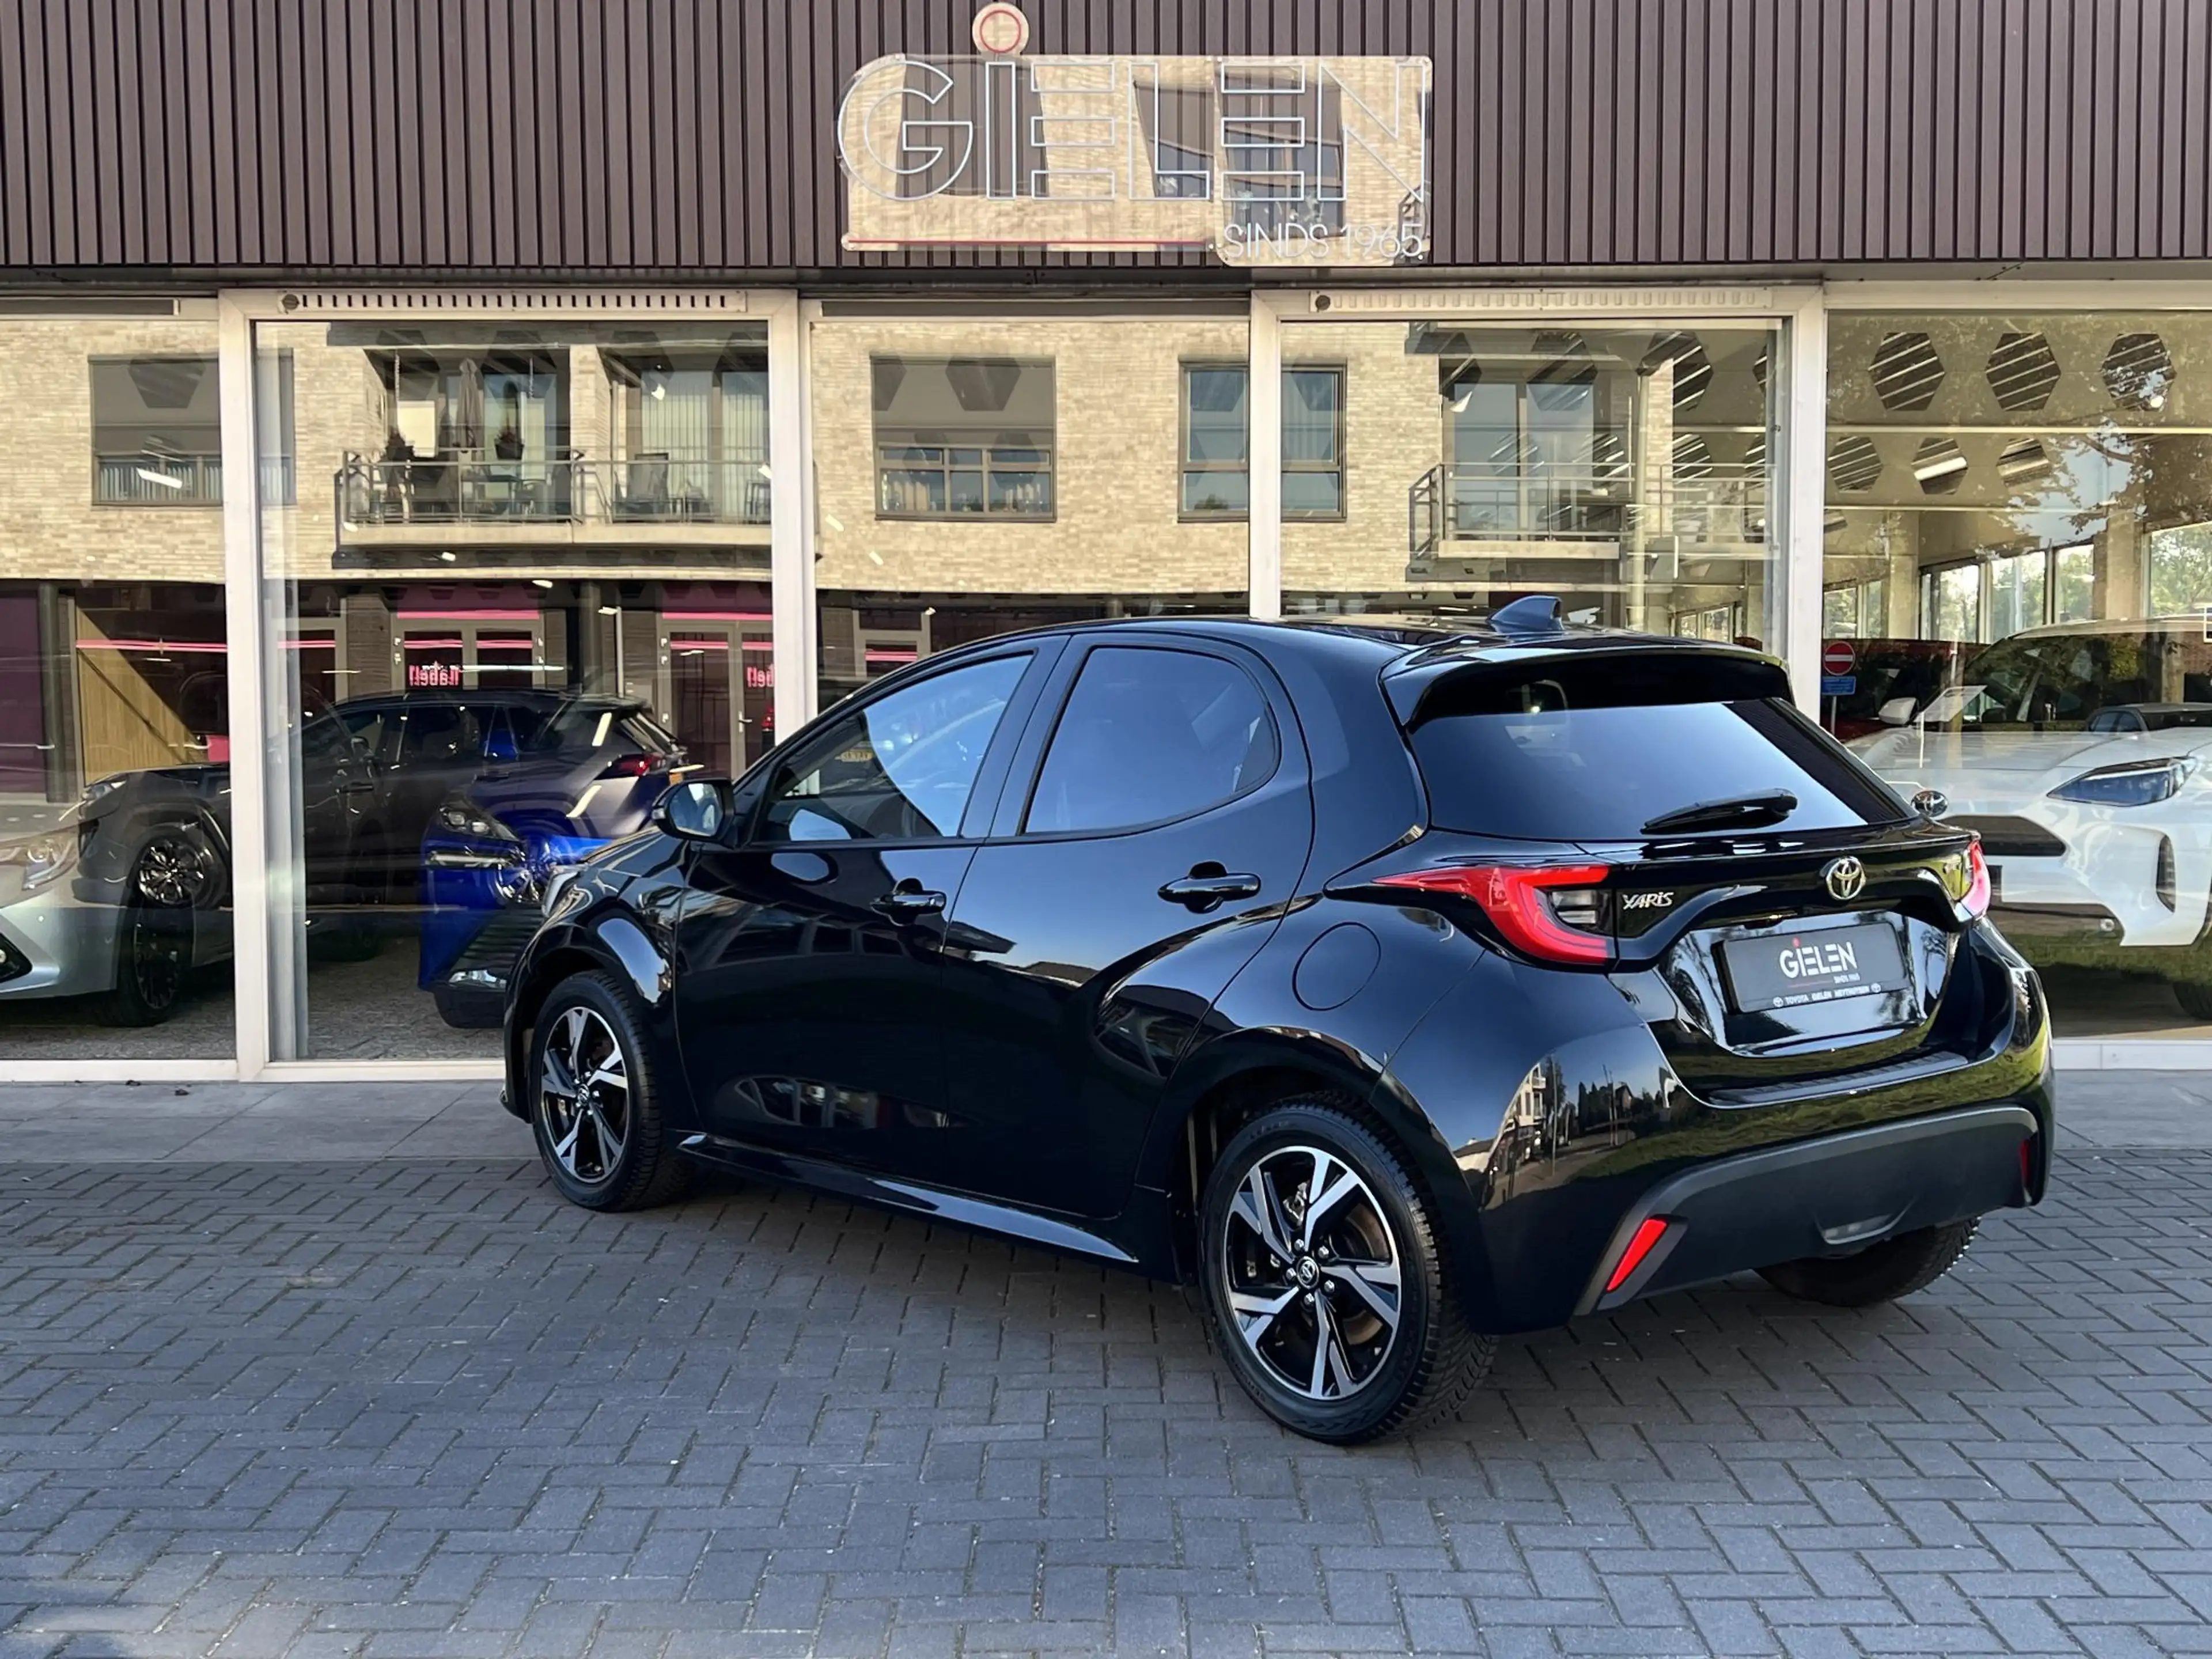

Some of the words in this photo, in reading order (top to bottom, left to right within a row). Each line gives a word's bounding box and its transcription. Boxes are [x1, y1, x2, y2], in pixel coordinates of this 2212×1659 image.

[838, 9, 1426, 202] GIELEN
[1224, 222, 1329, 259] SINDS
[1340, 223, 1423, 259] 1965
[1779, 937, 1858, 979] GIELEN
[1785, 994, 1809, 1006] TOYOTA
